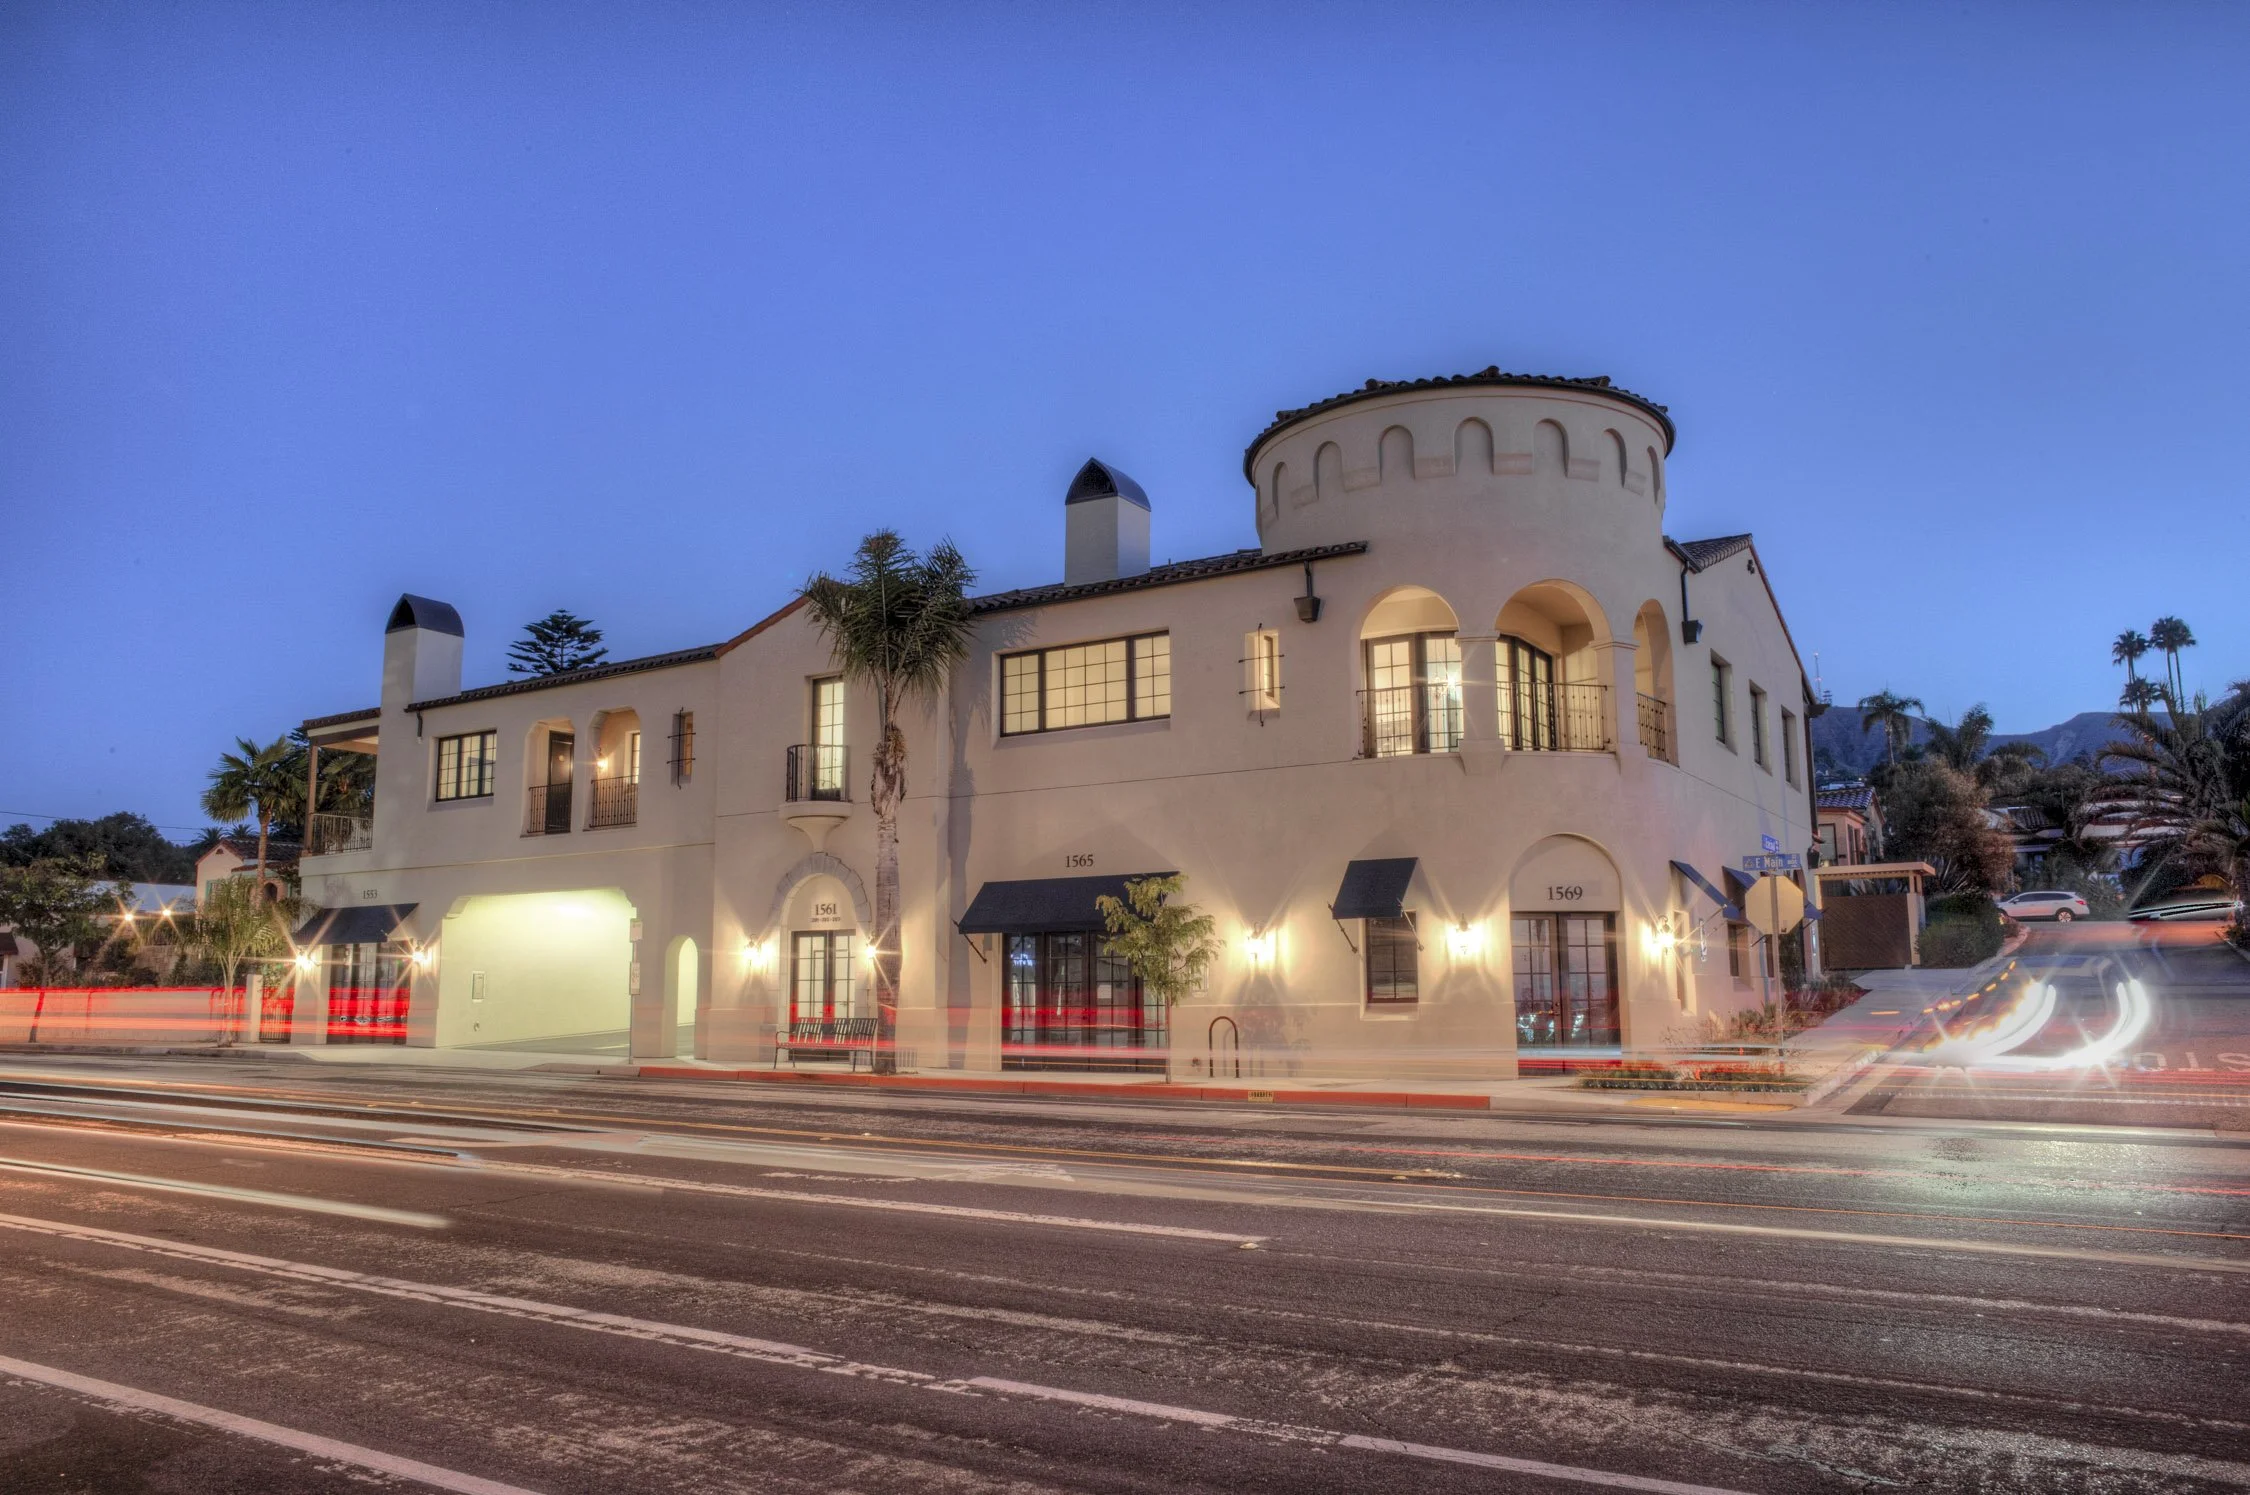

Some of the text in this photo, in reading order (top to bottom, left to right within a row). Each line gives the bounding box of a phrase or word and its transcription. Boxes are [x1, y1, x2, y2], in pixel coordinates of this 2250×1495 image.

[1065, 854, 1094, 868] 1565
[1755, 857, 1761, 869] E
[1763, 855, 1784, 868] Main
[363, 889, 378, 900] 1553
[1547, 886, 1583, 901] 1569
[815, 903, 837, 916] 1561
[2128, 1051, 2250, 1073] STO
